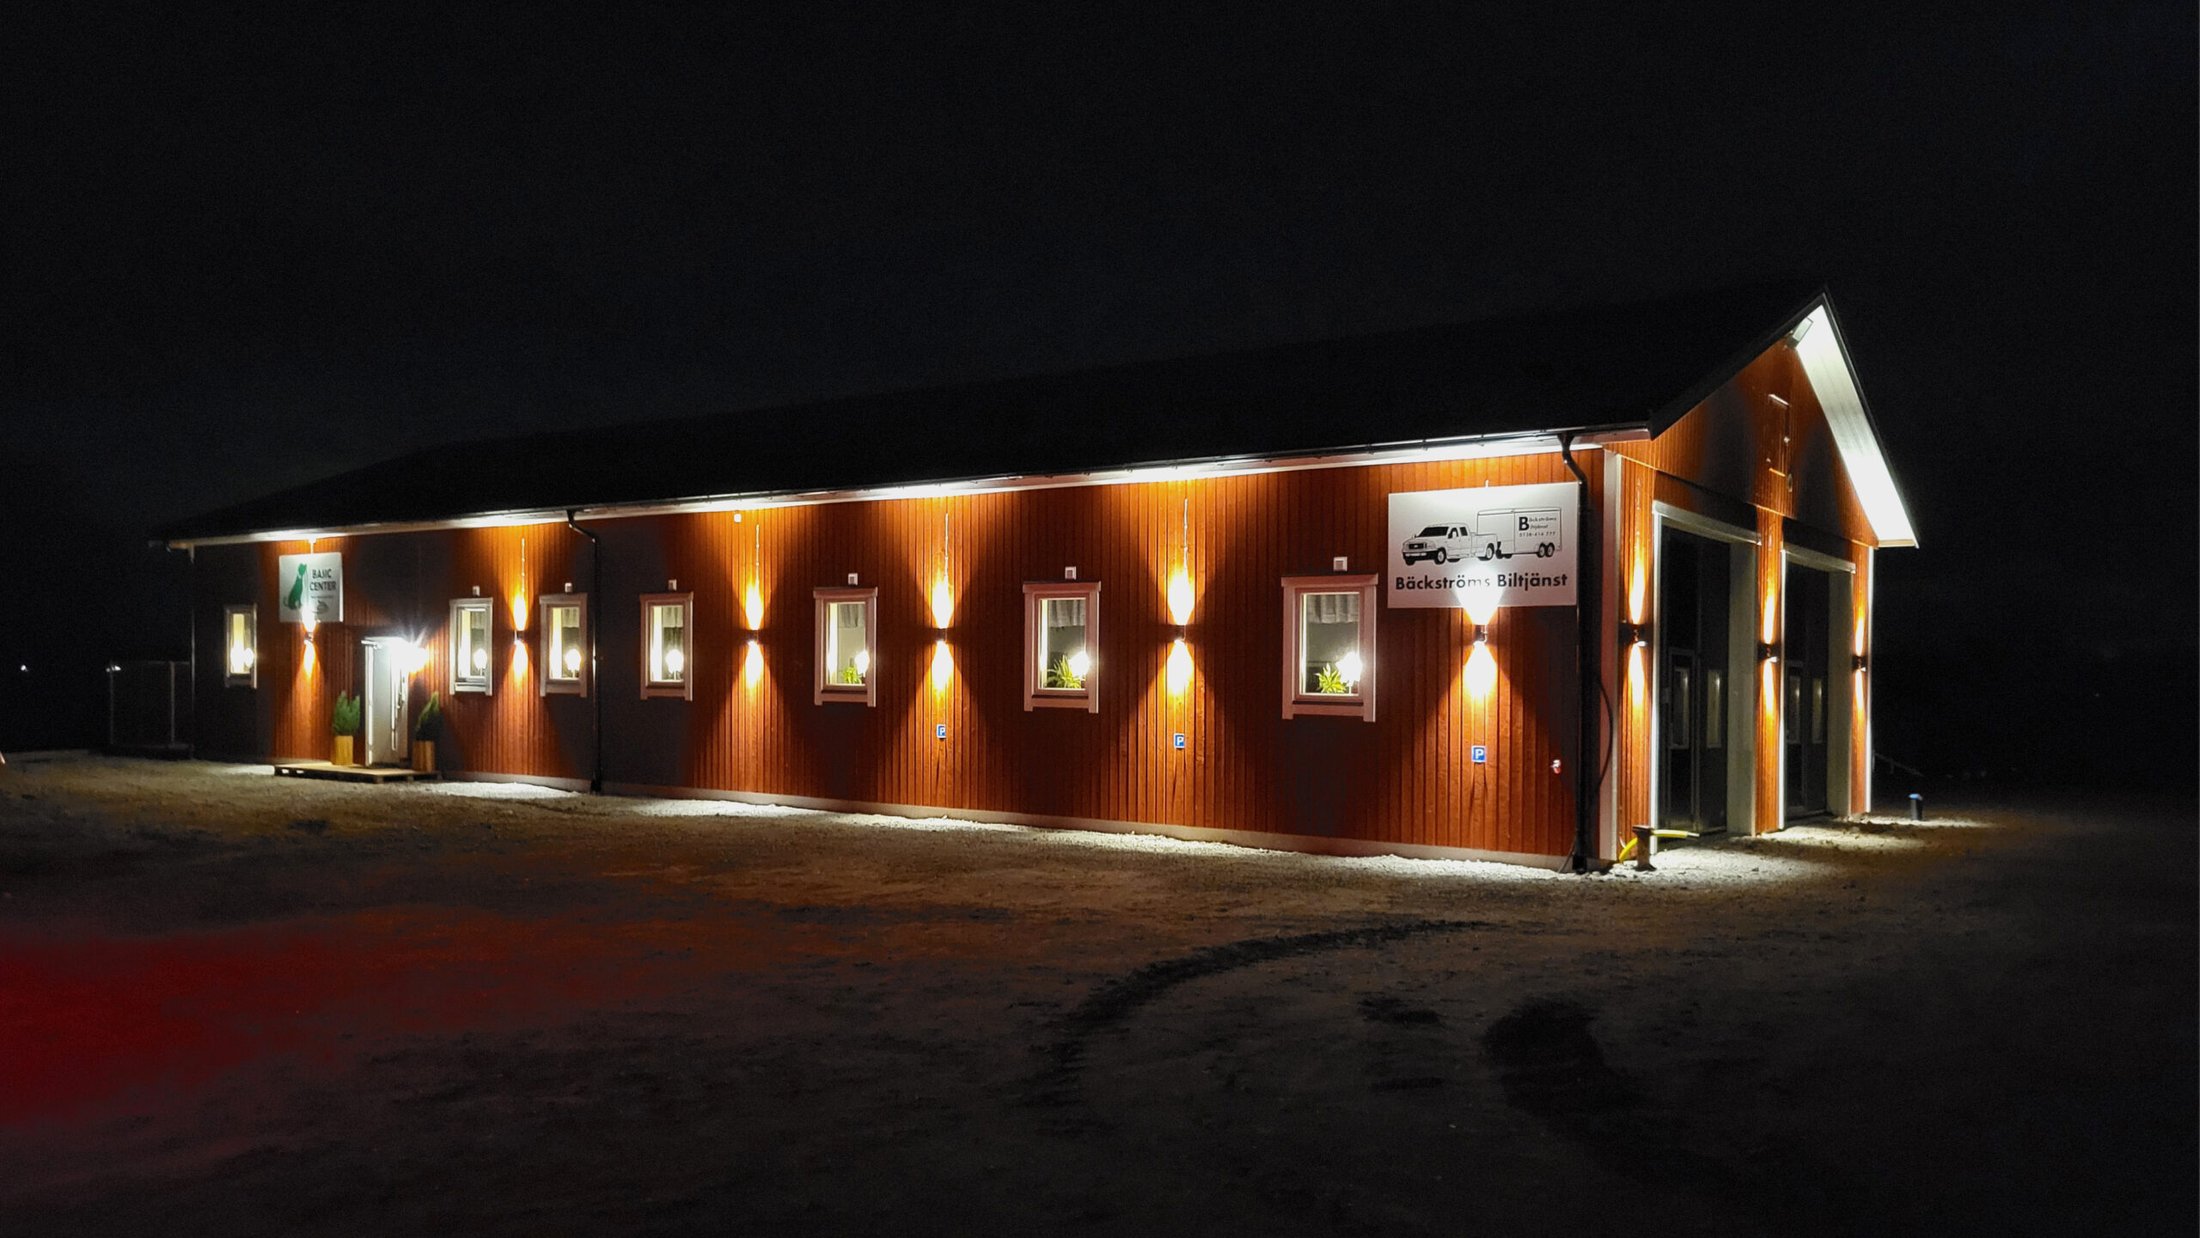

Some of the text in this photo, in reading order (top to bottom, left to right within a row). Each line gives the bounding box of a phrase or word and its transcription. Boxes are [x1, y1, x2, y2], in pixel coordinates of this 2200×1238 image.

[309, 581, 337, 591] CENTER
[1395, 572, 1568, 591] Bäckströms Biltjänst
[1475, 748, 1484, 761] P
